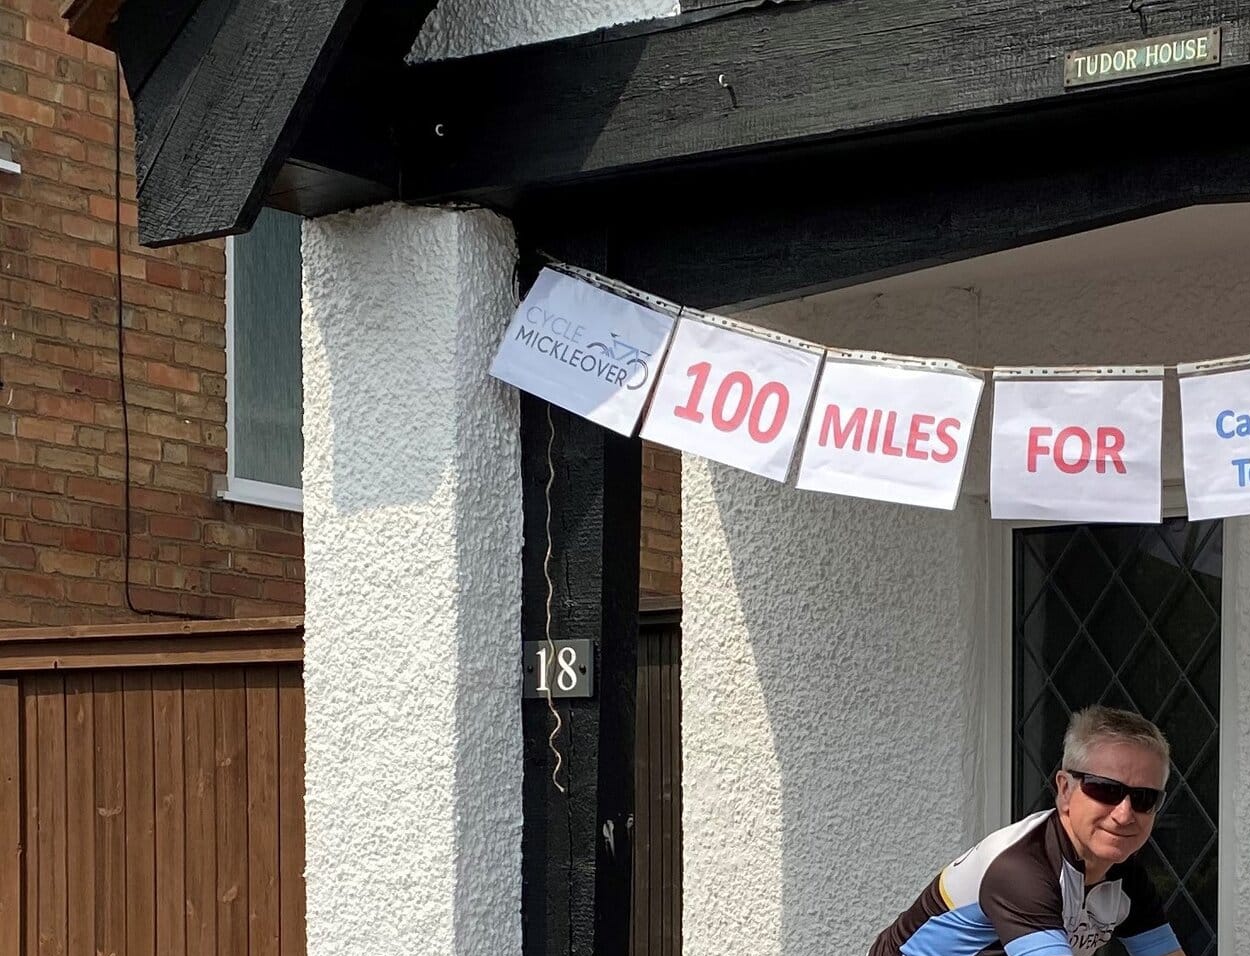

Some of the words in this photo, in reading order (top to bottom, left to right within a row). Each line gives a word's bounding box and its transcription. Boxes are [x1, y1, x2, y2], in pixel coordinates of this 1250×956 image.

[1074, 48, 1137, 78] TUDOR
[1145, 36, 1208, 67] HOUSE
[525, 305, 586, 342] CYCLE
[515, 325, 629, 389] MICKLEOVER
[674, 362, 790, 444] 100
[819, 404, 961, 464] MILES
[1026, 426, 1127, 475] FOR
[535, 646, 577, 691] 18
